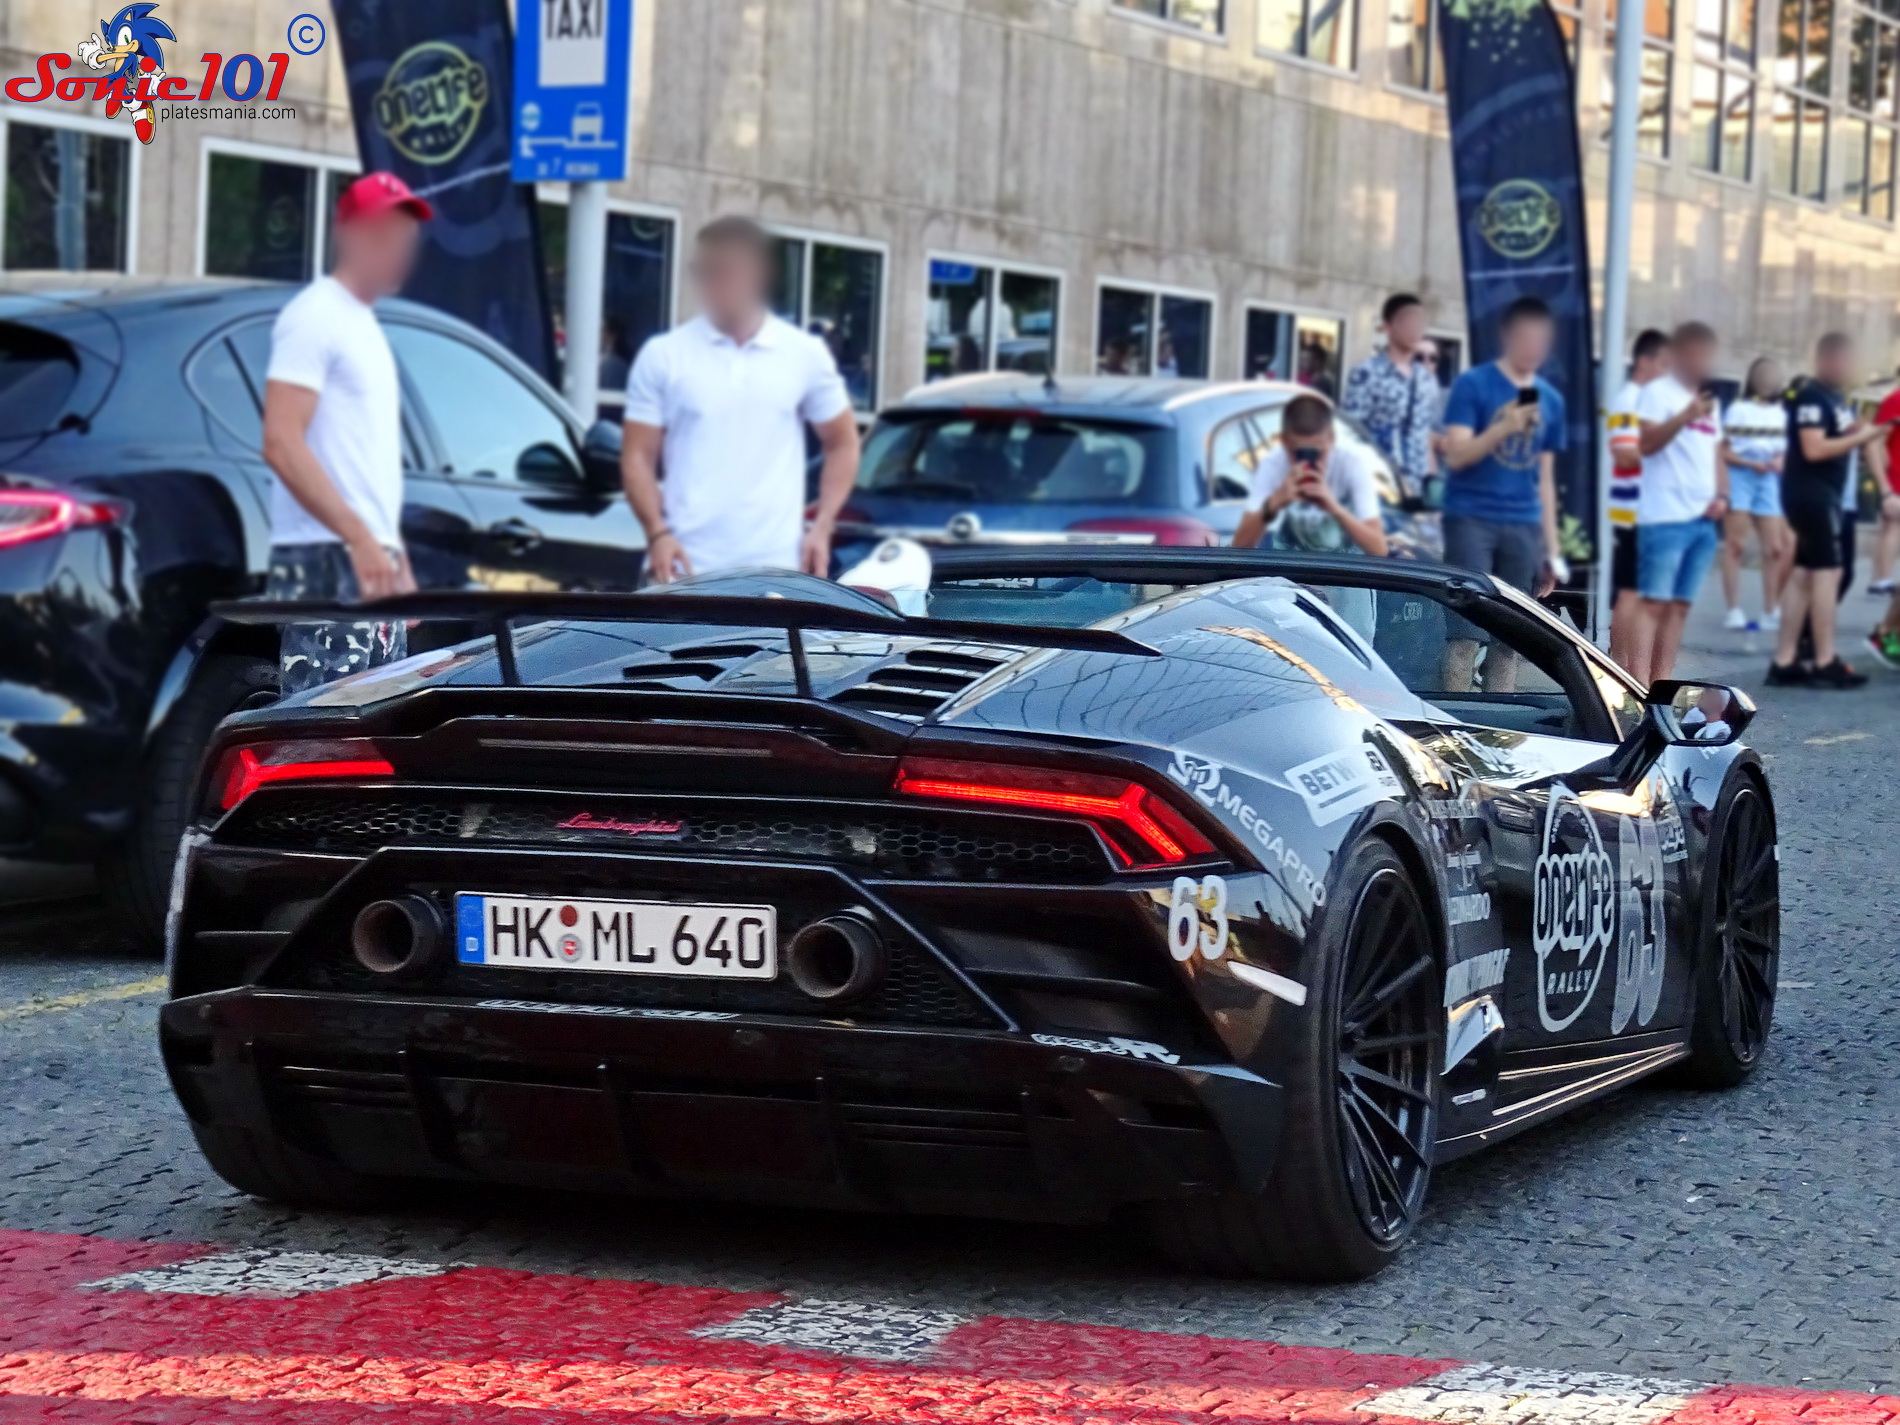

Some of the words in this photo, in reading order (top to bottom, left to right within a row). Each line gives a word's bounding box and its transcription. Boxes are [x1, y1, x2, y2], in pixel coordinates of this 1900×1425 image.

[543, 0, 602, 39] TAXI
[1217, 785, 1327, 907] MEGAPRO
[492, 905, 554, 958] HK
[592, 910, 655, 963] ML
[672, 914, 765, 968] 640
[1168, 874, 1228, 961] 63
[1611, 813, 1666, 1035] 63
[1546, 969, 1593, 995] RALLY
